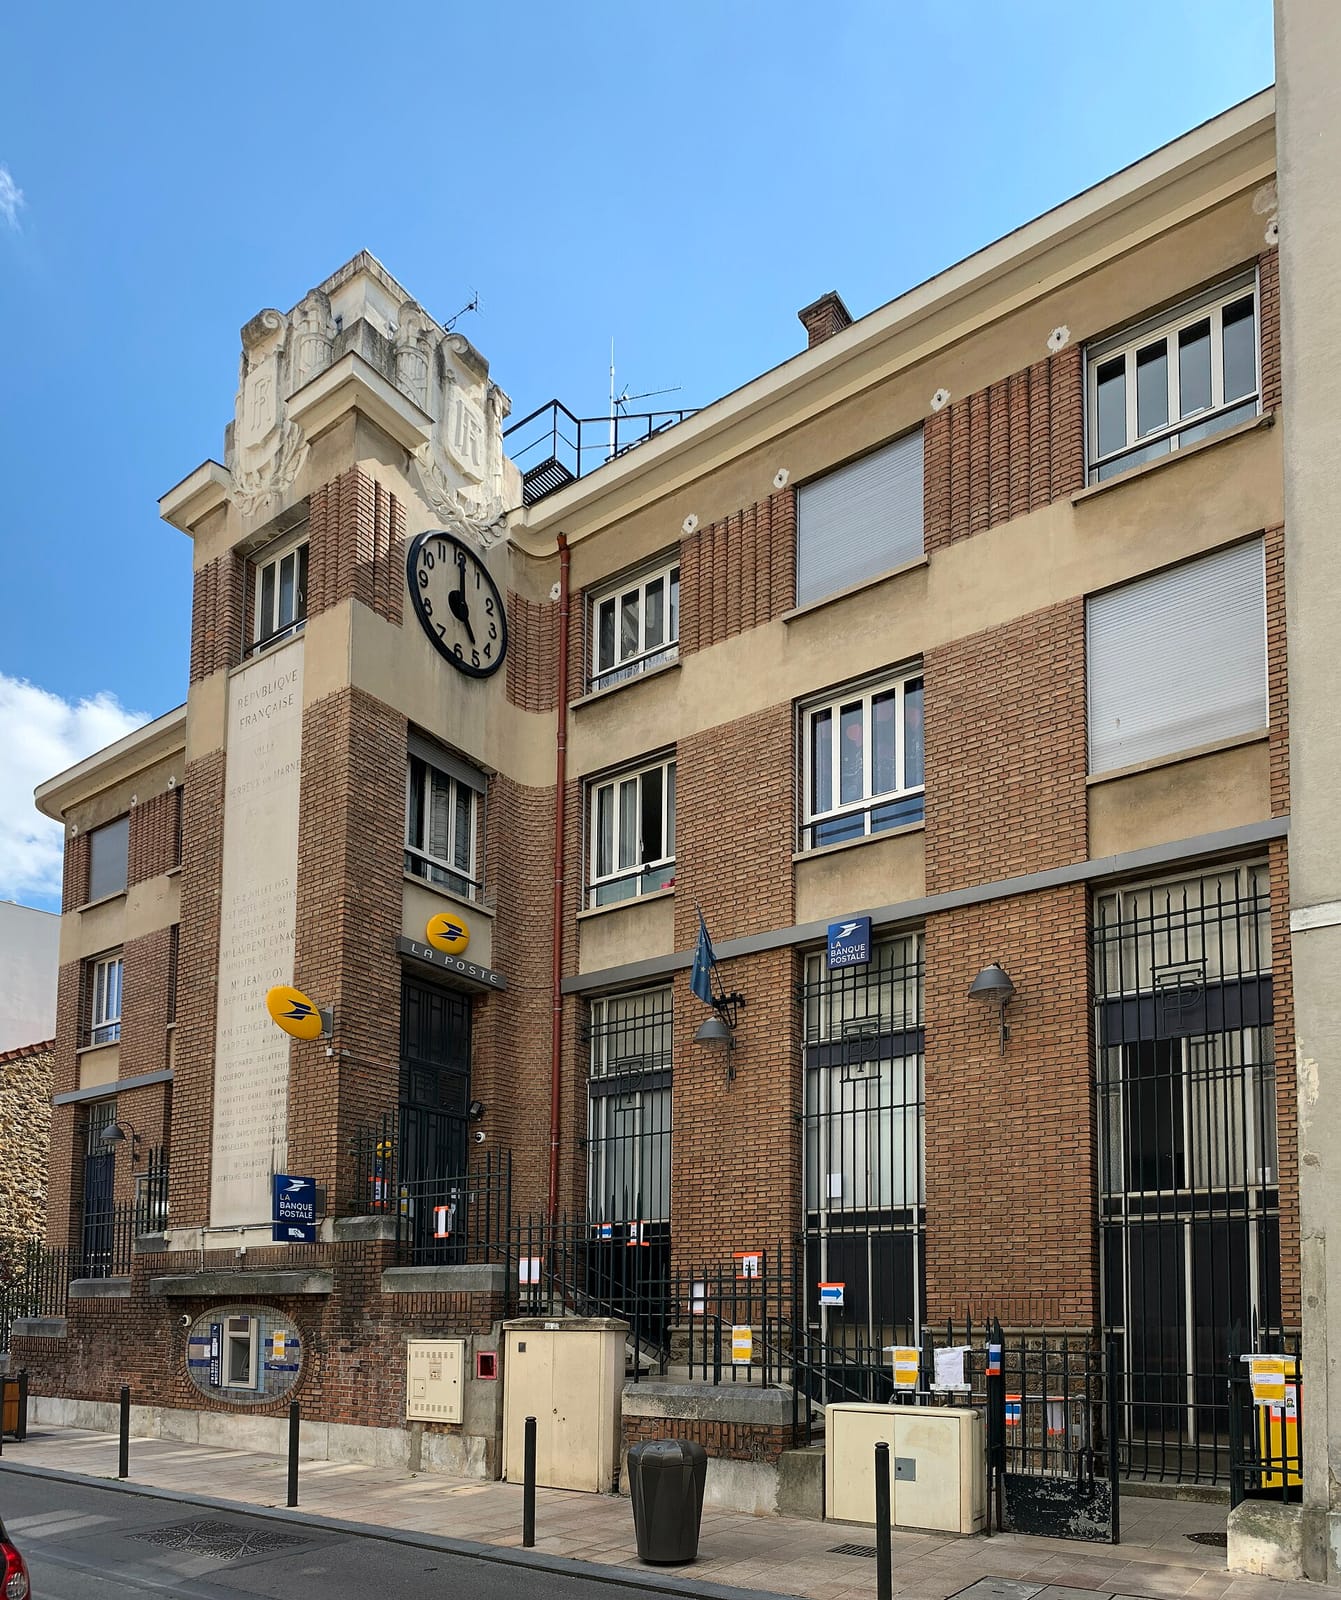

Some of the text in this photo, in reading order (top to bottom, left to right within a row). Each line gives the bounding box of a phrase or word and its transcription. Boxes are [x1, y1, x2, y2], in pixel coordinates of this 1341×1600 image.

[422, 548, 435, 570] 10
[438, 541, 446, 563] 11
[418, 569, 429, 589] 9
[475, 572, 480, 590] 1
[423, 597, 433, 617] 8
[485, 597, 494, 617] 2
[436, 622, 447, 639] 7
[488, 622, 497, 640] 3
[453, 642, 463, 661] 6
[471, 649, 480, 668] 5
[483, 642, 492, 660] 4
[830, 940, 842, 950] LA
[830, 943, 866, 957] BANQUE
[411, 943, 498, 984] LA POSTE
[830, 951, 866, 965] POSTALE
[279, 1193, 291, 1201] LA
[279, 1201, 313, 1211] BANQUE
[279, 1209, 313, 1219] POSTALE
